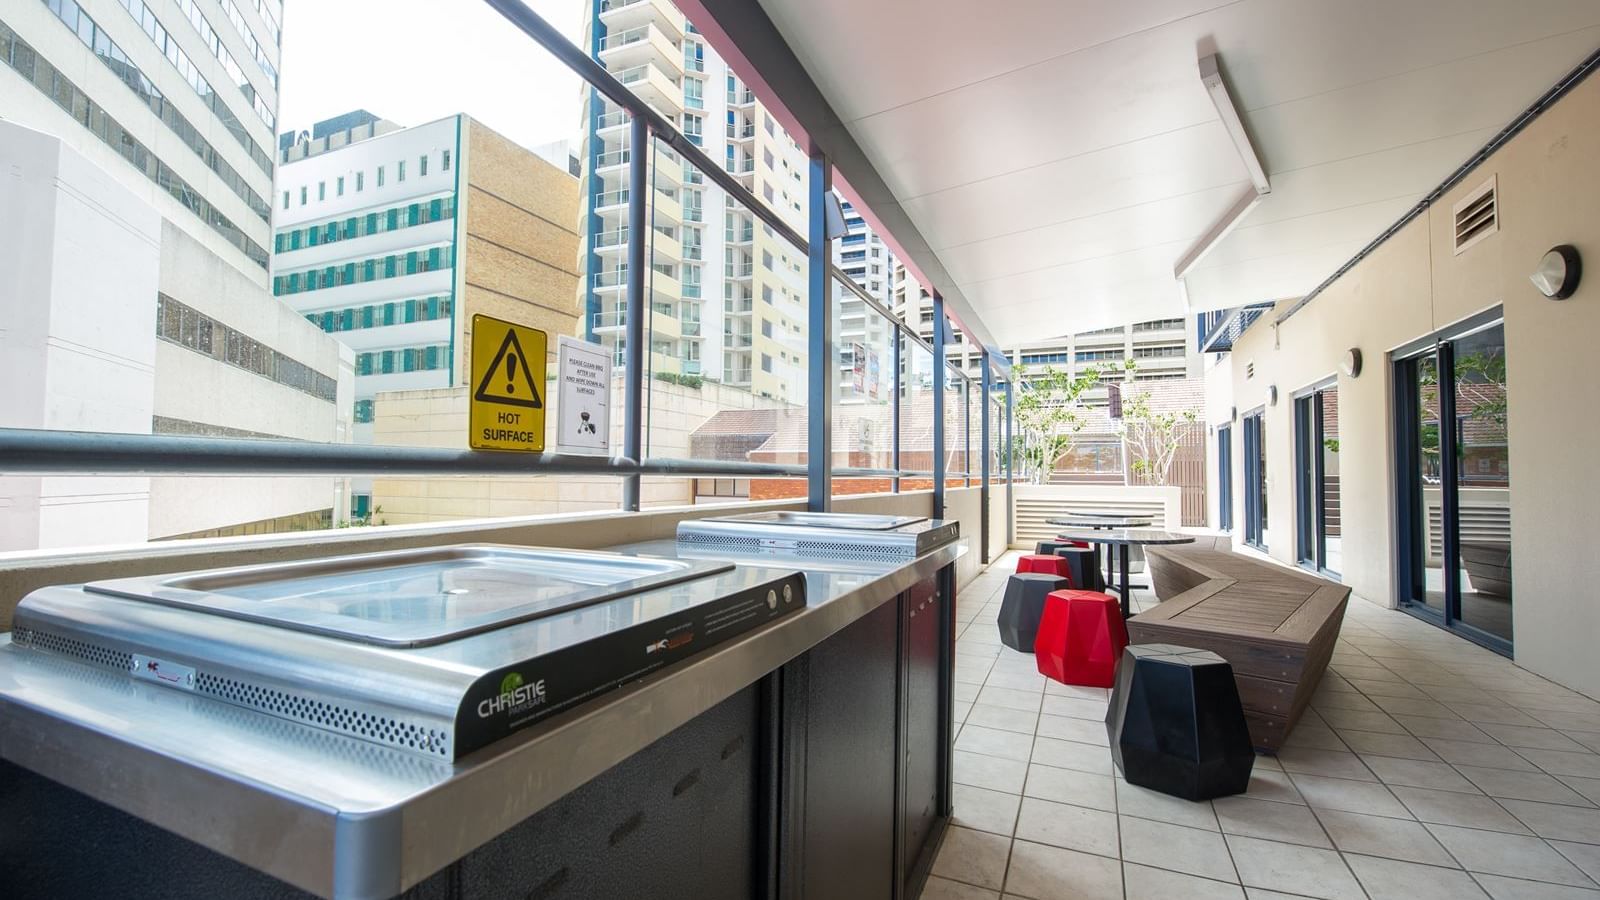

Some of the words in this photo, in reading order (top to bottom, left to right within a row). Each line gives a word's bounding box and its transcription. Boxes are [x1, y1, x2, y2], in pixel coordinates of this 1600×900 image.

[569, 358, 583, 367] PLEASE
[577, 369, 588, 377] AFTER
[566, 375, 575, 383] AND
[576, 387, 595, 395] SURFACES
[498, 412, 521, 425] HOT
[483, 428, 534, 443] SURFACE
[477, 679, 546, 718] CHRISTIE
